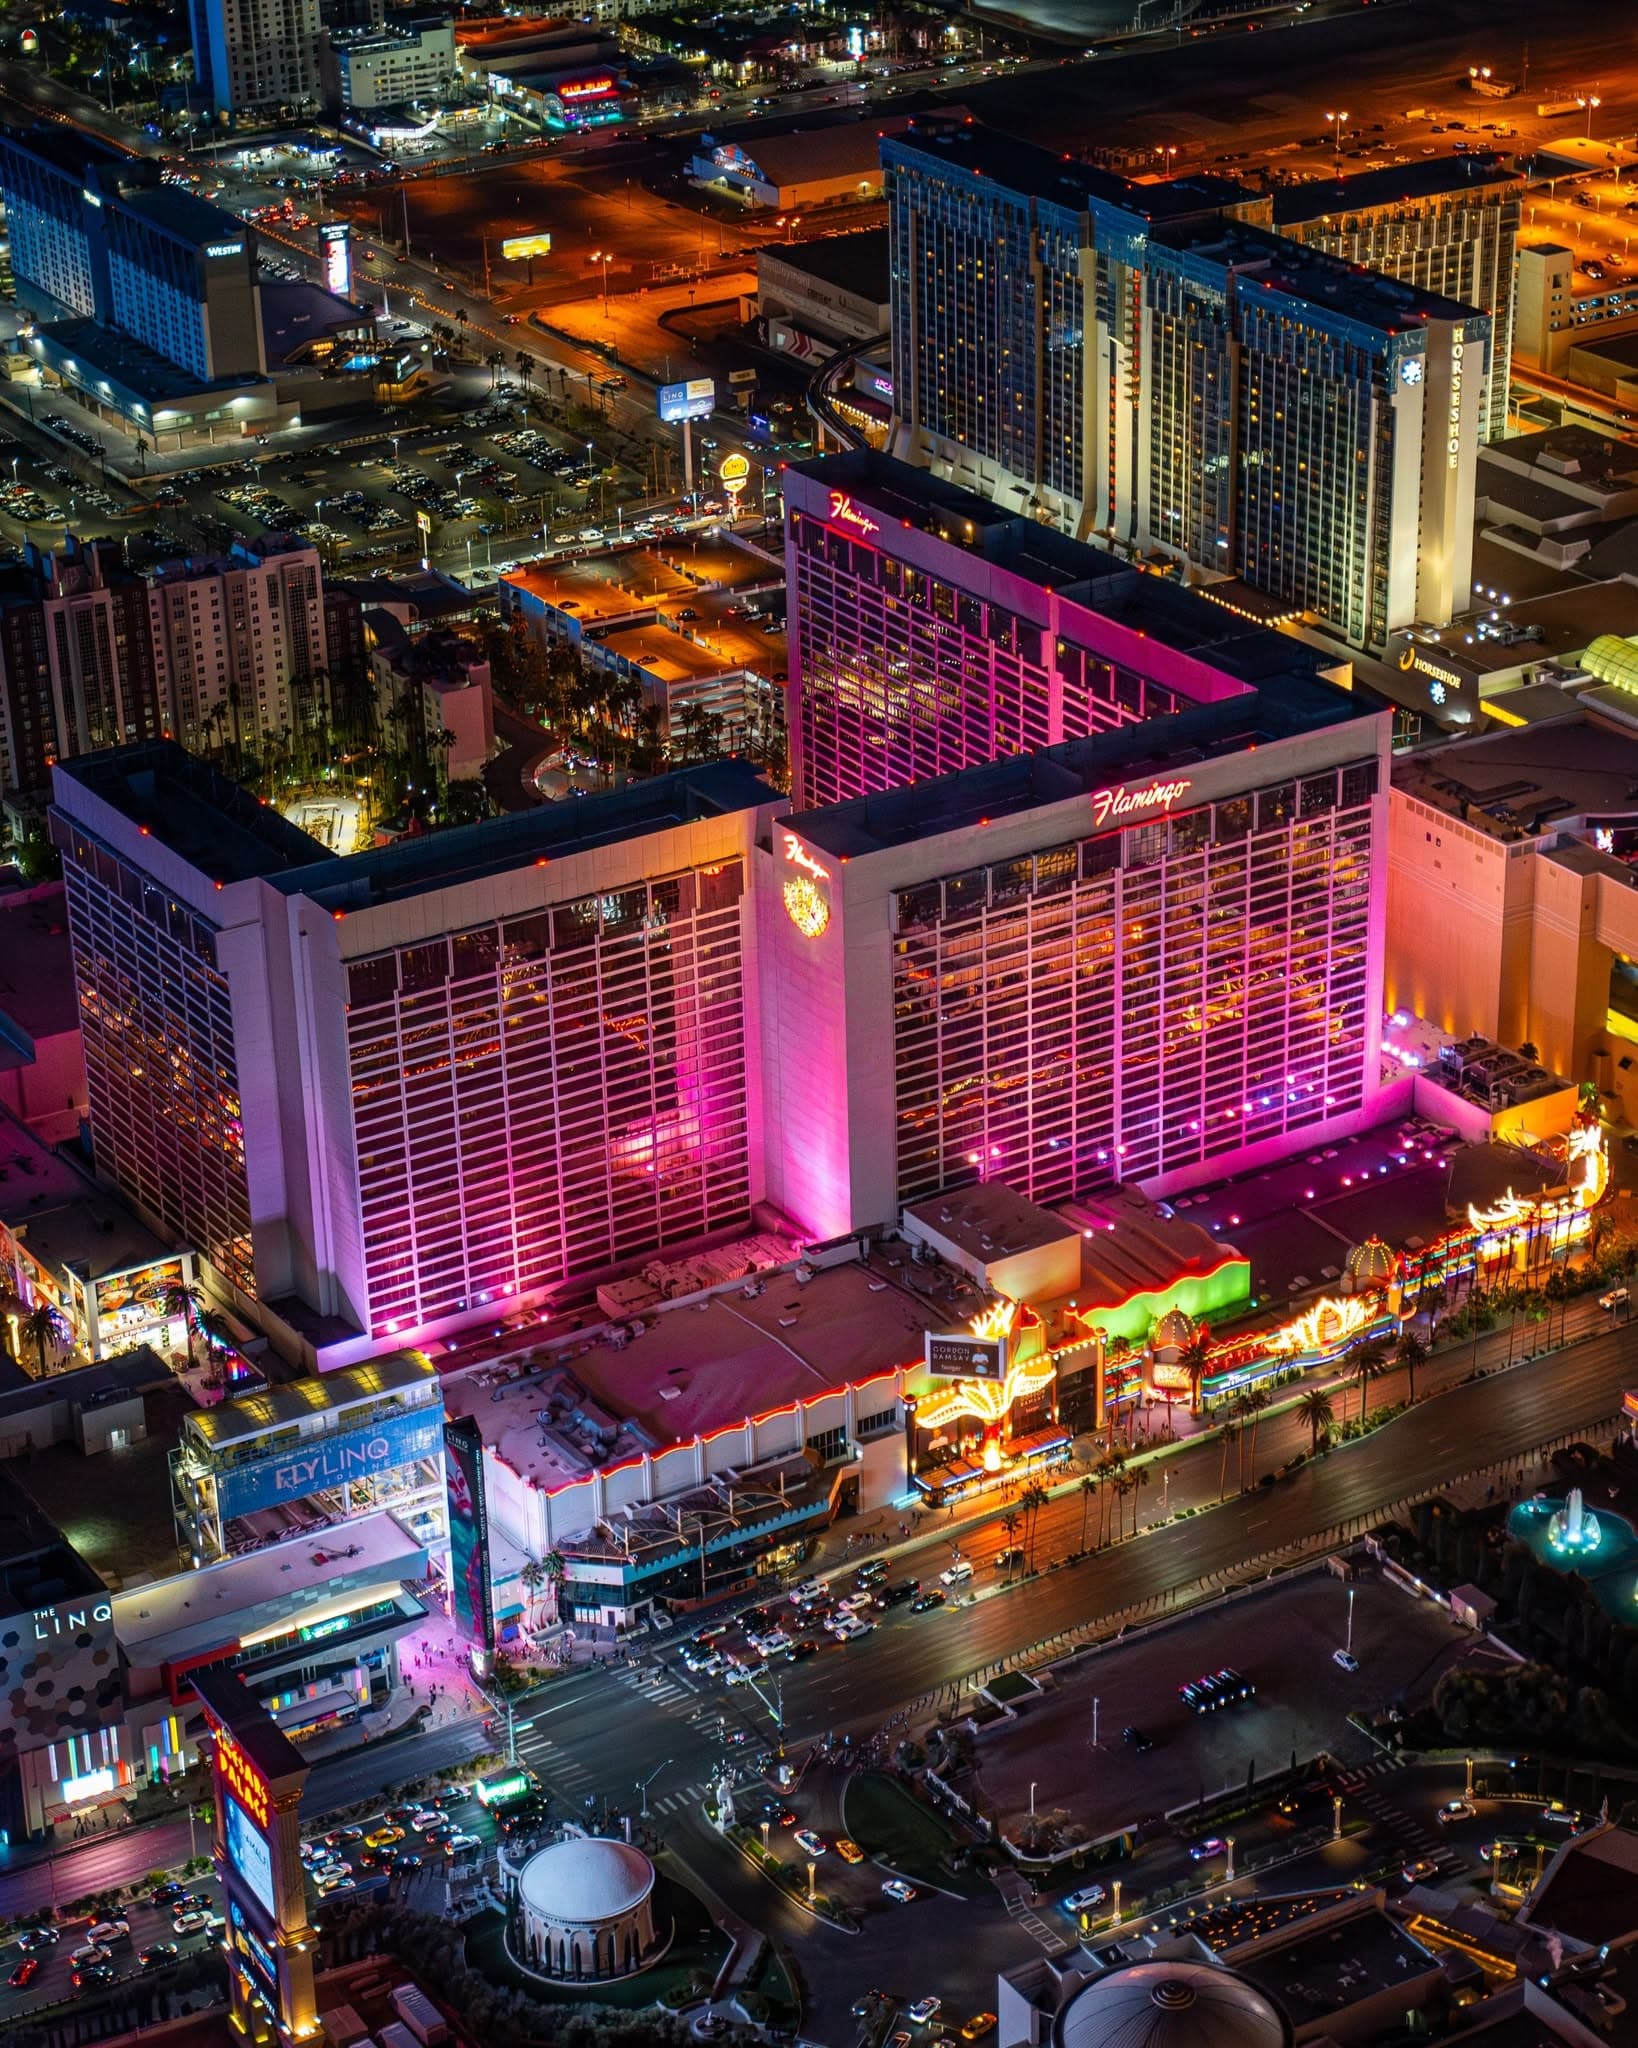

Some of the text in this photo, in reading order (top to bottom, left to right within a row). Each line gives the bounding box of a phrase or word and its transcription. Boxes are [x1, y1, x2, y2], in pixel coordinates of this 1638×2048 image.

[207, 244, 242, 257] WESTIN
[1448, 330, 1464, 468] HORSESHOE
[830, 493, 880, 535] Flamingo
[1414, 657, 1462, 689] HORSESHOE
[1093, 781, 1191, 827] Flamingo
[932, 1346, 970, 1354] GORDON
[33, 1608, 56, 1621] THE
[35, 1605, 112, 1640] LINQ
[220, 1750, 268, 1828] PALACE
